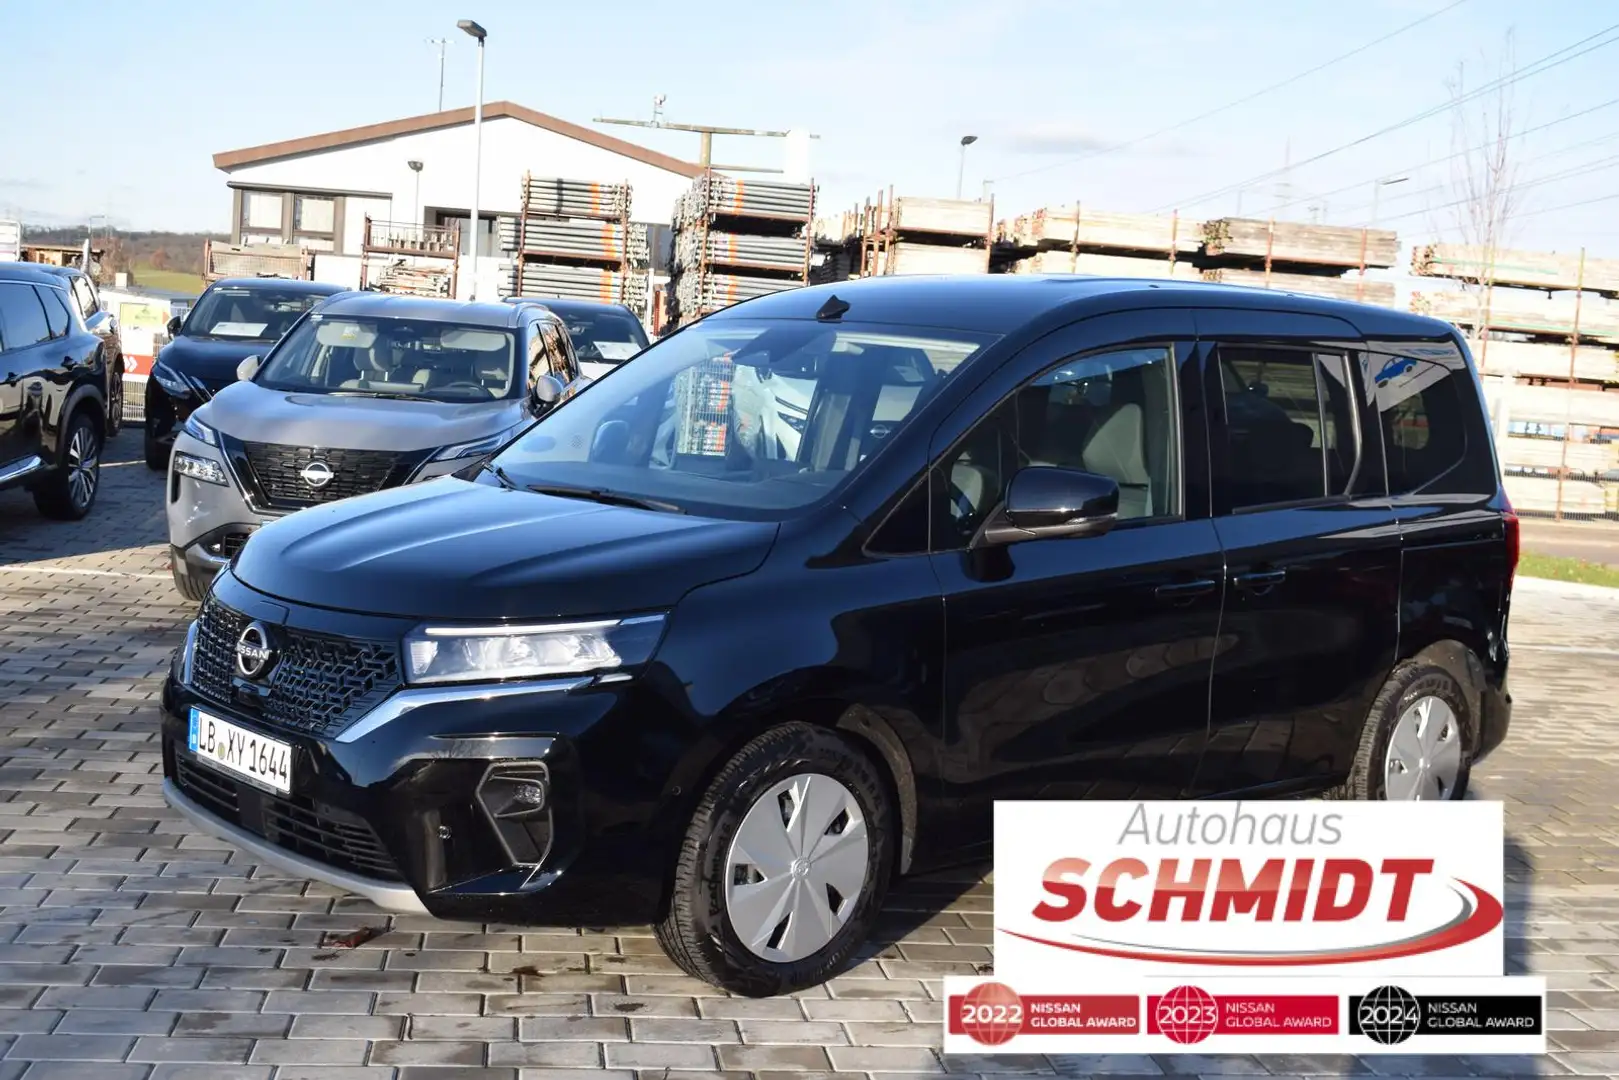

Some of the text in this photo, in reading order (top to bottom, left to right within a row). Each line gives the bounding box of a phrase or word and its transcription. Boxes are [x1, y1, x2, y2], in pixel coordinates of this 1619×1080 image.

[199, 717, 216, 753] LB
[227, 729, 246, 766] XY
[248, 739, 288, 784] 1644
